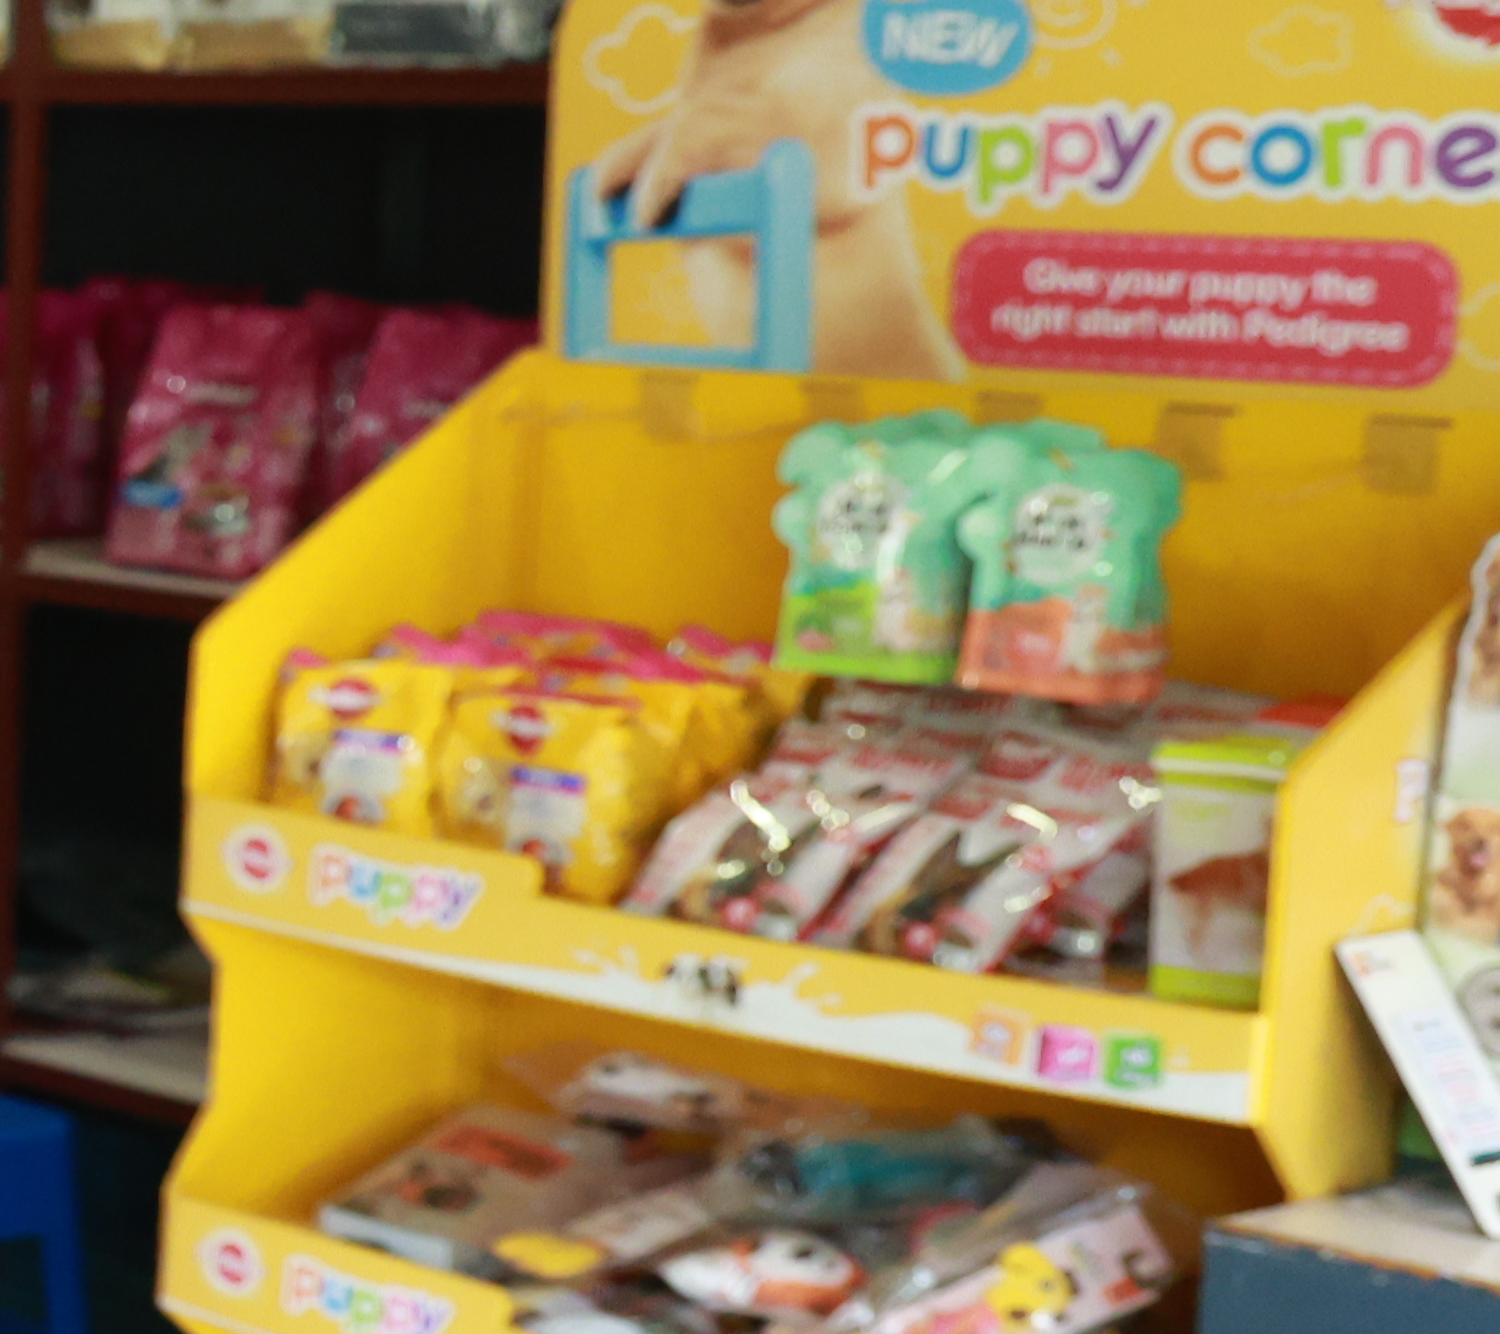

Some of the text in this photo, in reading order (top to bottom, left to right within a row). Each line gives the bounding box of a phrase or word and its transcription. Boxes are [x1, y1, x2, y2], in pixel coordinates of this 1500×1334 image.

[880, 12, 1018, 67] NEW
[861, 113, 1158, 205] puppy
[1023, 258, 1379, 314] Give your puppy the
[992, 302, 1411, 357] right start with Pedigree
